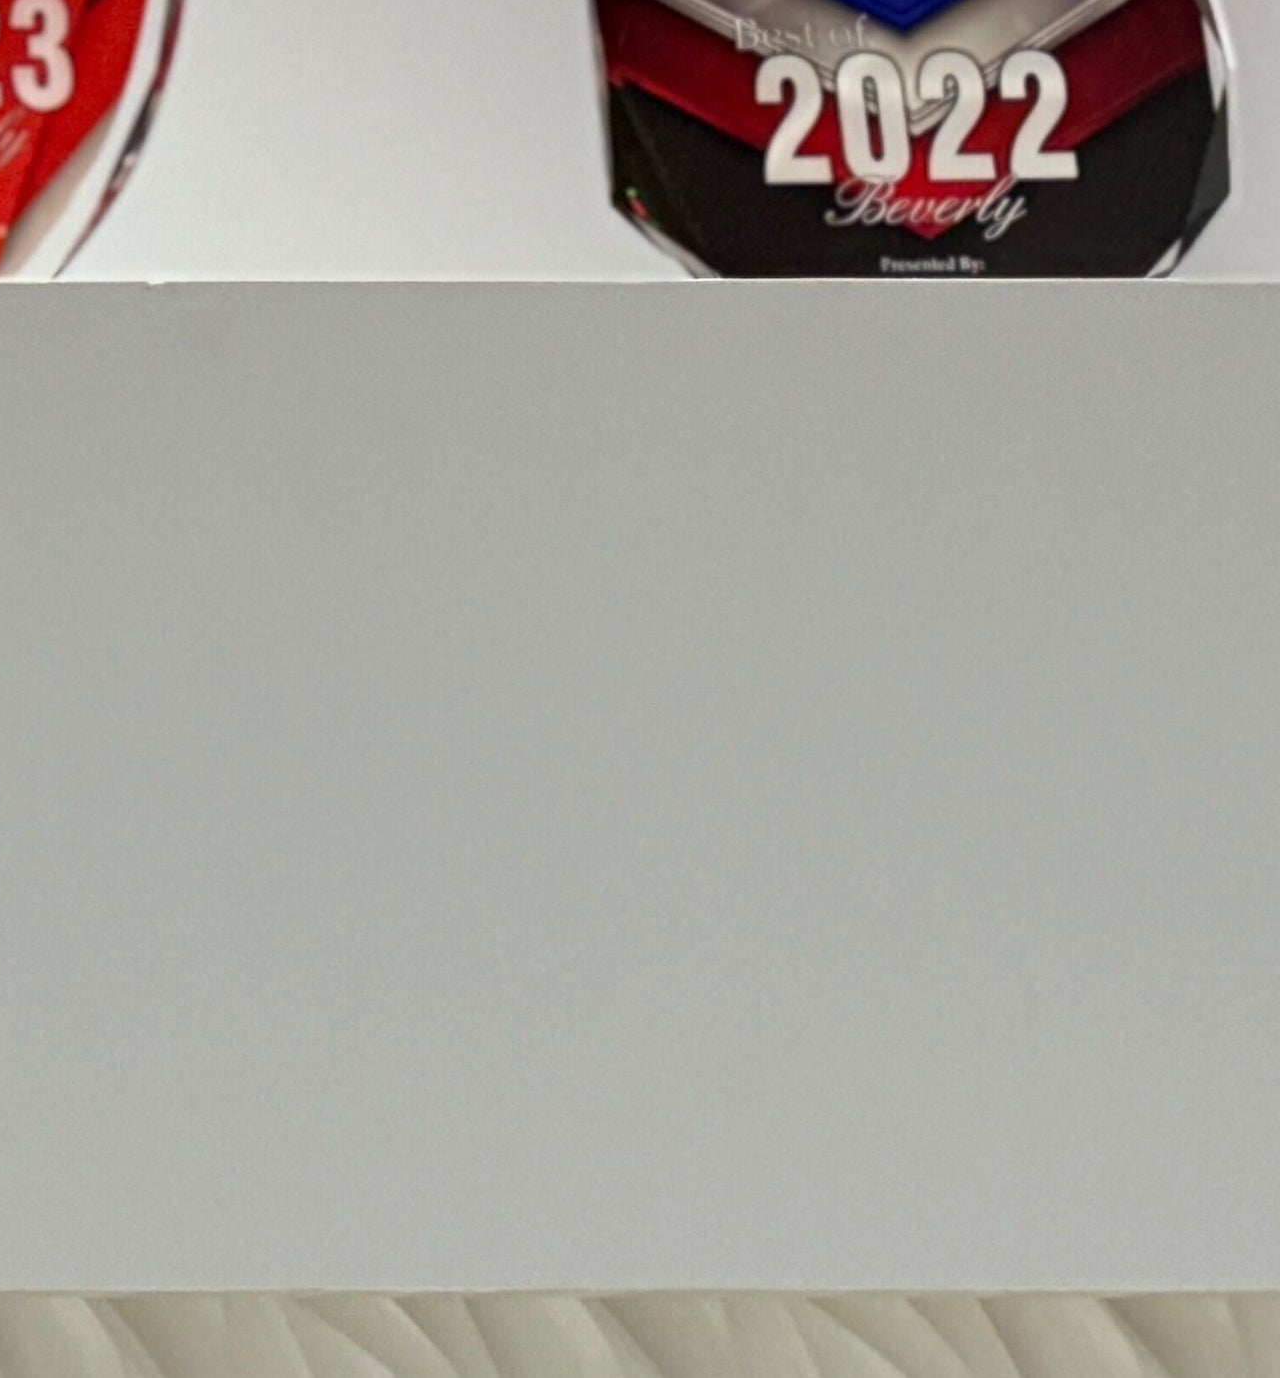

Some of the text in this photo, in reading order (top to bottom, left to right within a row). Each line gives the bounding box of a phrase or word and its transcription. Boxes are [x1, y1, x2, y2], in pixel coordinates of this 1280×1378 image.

[736, 12, 868, 50] Best of
[754, 49, 1079, 185] 2022
[823, 174, 1028, 241] Beverly
[880, 256, 986, 274] Presented By:
